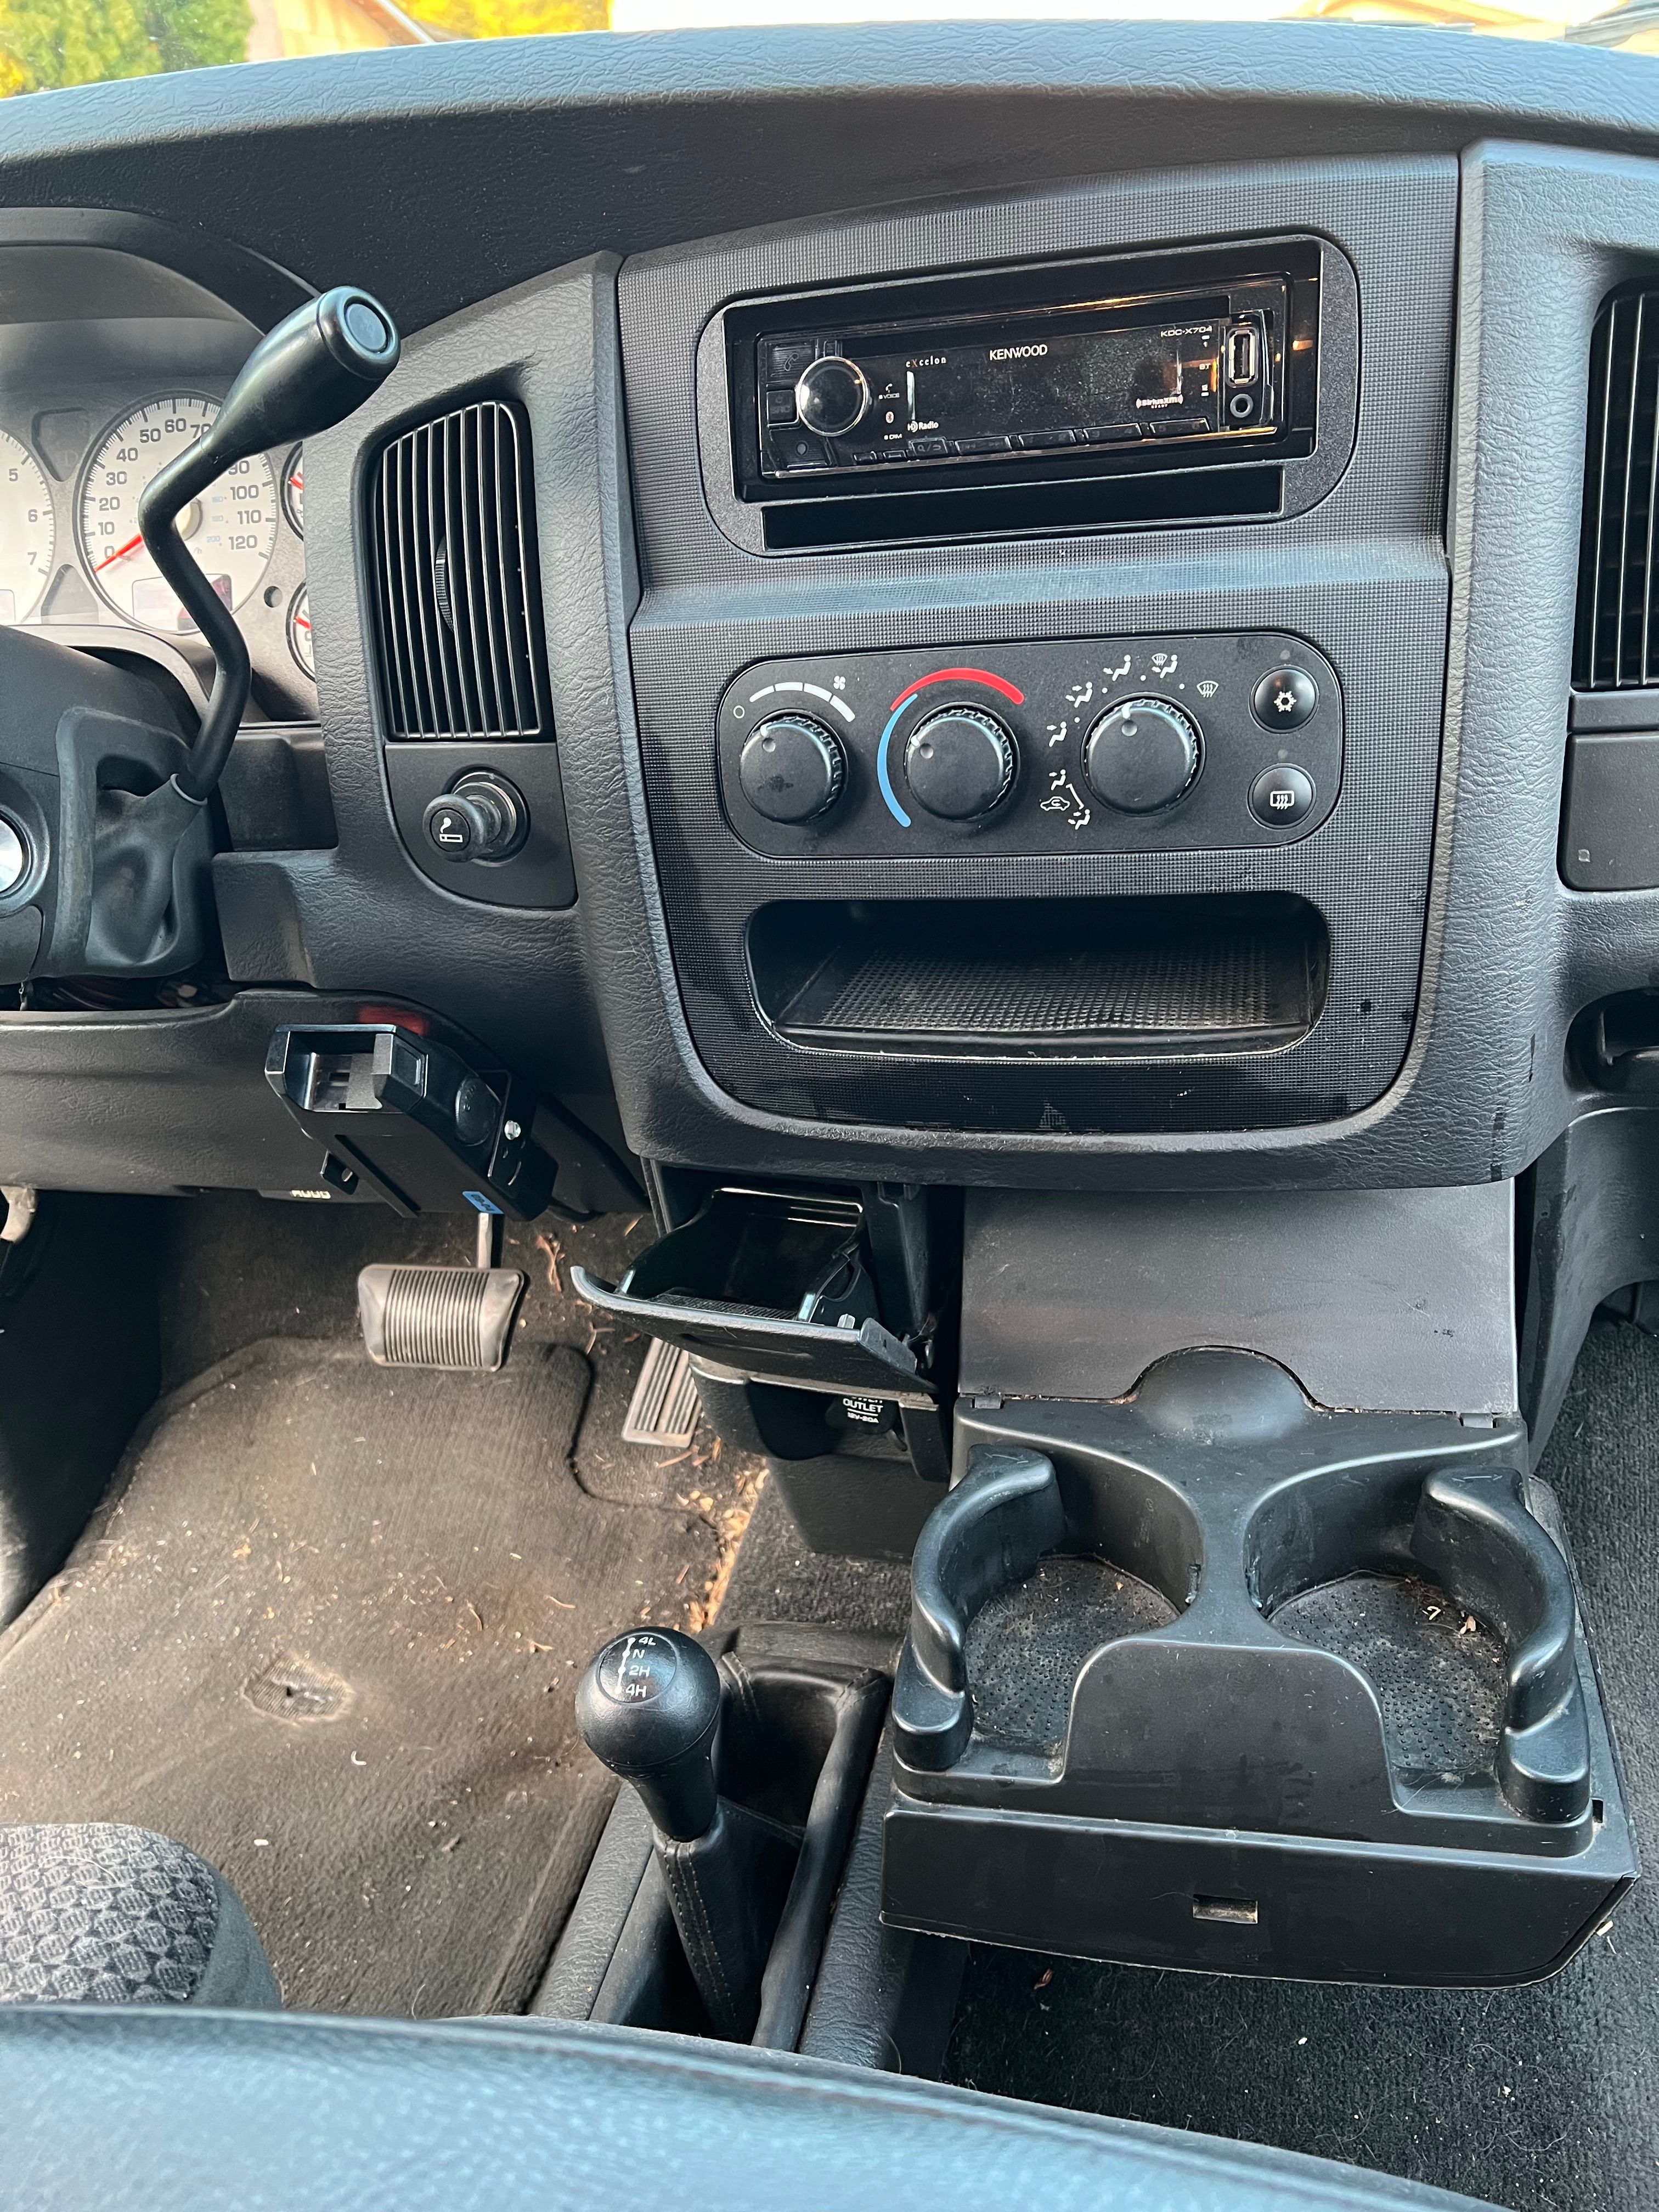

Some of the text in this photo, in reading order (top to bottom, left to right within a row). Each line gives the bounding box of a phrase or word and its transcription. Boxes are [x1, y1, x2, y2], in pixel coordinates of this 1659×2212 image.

[989, 345, 1048, 360] KENWOOD
[165, 418, 186, 433] 60
[918, 421, 939, 430] Radio
[140, 428, 161, 443] 50
[116, 447, 138, 461] 40
[9, 468, 18, 482] 5
[106, 471, 127, 486] 30
[230, 484, 259, 500] 100
[99, 496, 120, 511] 20
[28, 509, 37, 522] 6
[237, 510, 261, 524] 110
[98, 521, 115, 535] 10
[228, 535, 257, 550] 120
[27, 551, 37, 565] 7
[104, 545, 115, 559] 0
[843, 1398, 884, 1413] OUTLET
[638, 1637, 656, 1646] 4L
[633, 1649, 645, 1659] N
[629, 1665, 651, 1677] 2H
[625, 1684, 647, 1697] 4H
